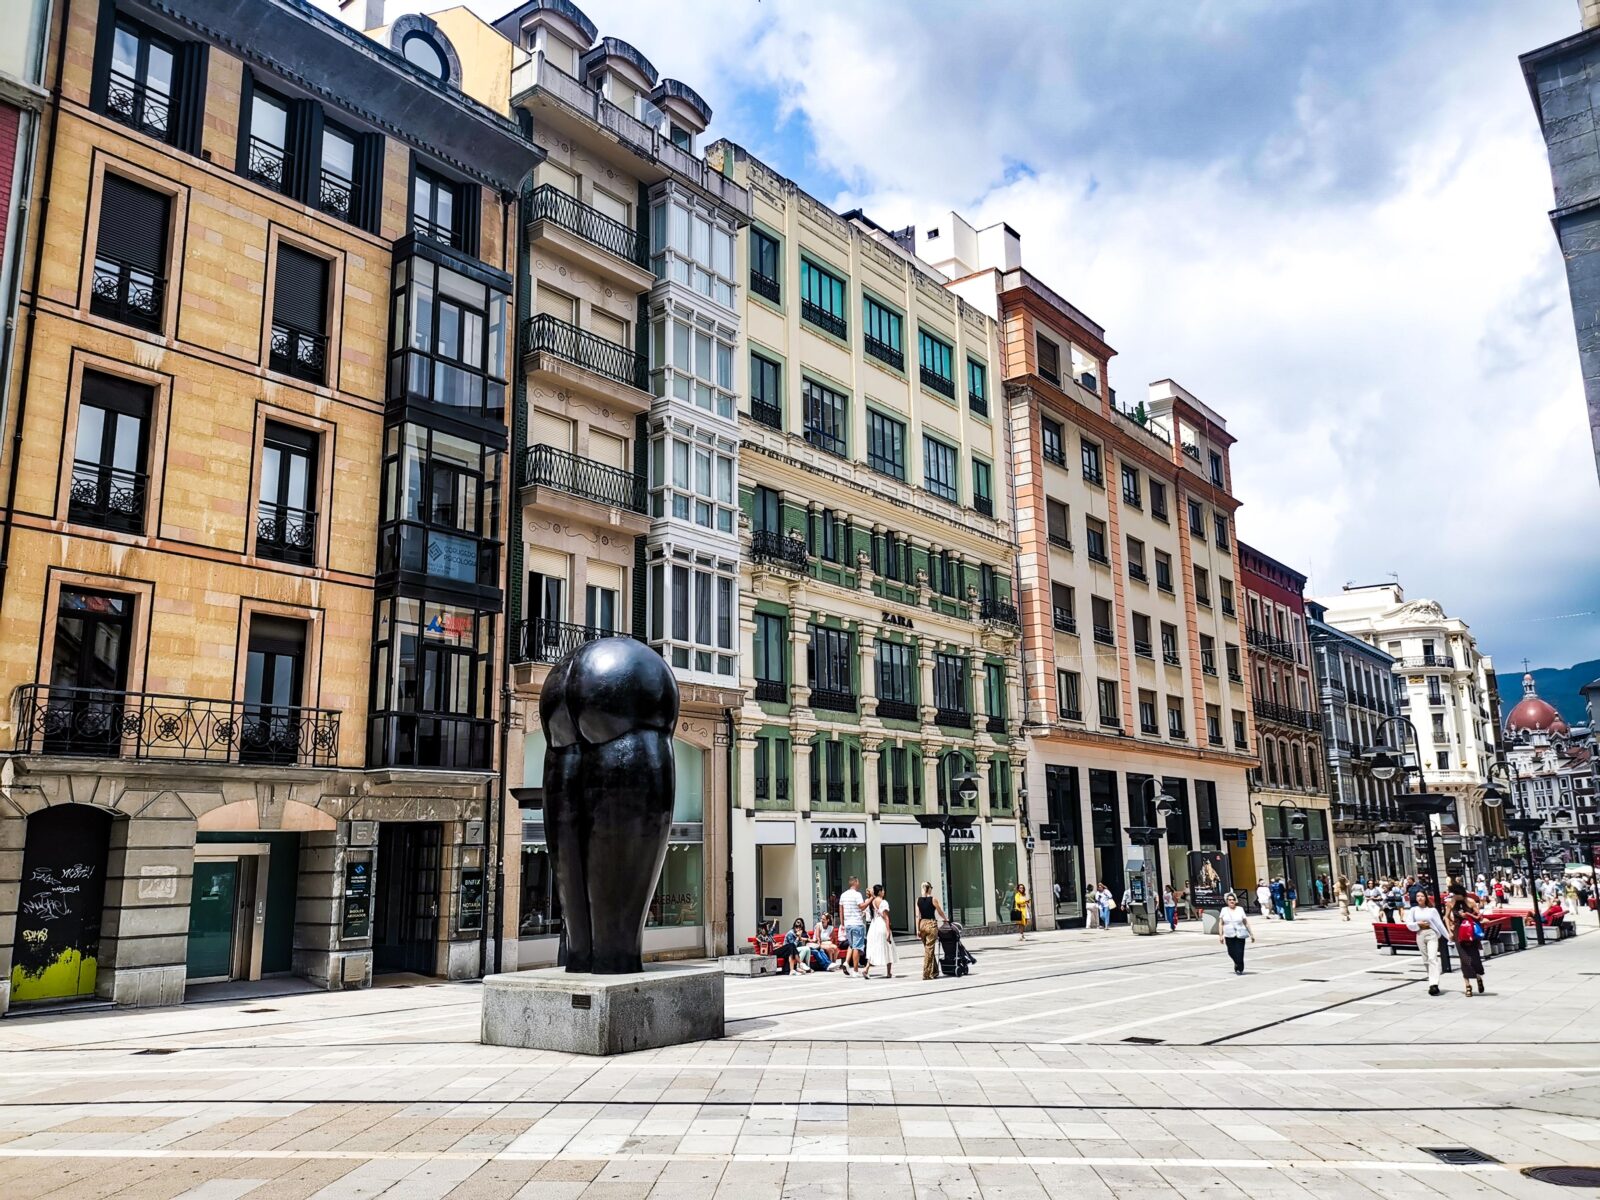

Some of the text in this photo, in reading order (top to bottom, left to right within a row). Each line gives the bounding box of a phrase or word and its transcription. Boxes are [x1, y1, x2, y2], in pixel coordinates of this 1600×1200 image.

[882, 611, 914, 628] ZARA
[470, 827, 480, 838] 7
[819, 827, 858, 839] ZARA
[949, 829, 975, 839] ARA
[655, 893, 691, 905] REBAJAS
